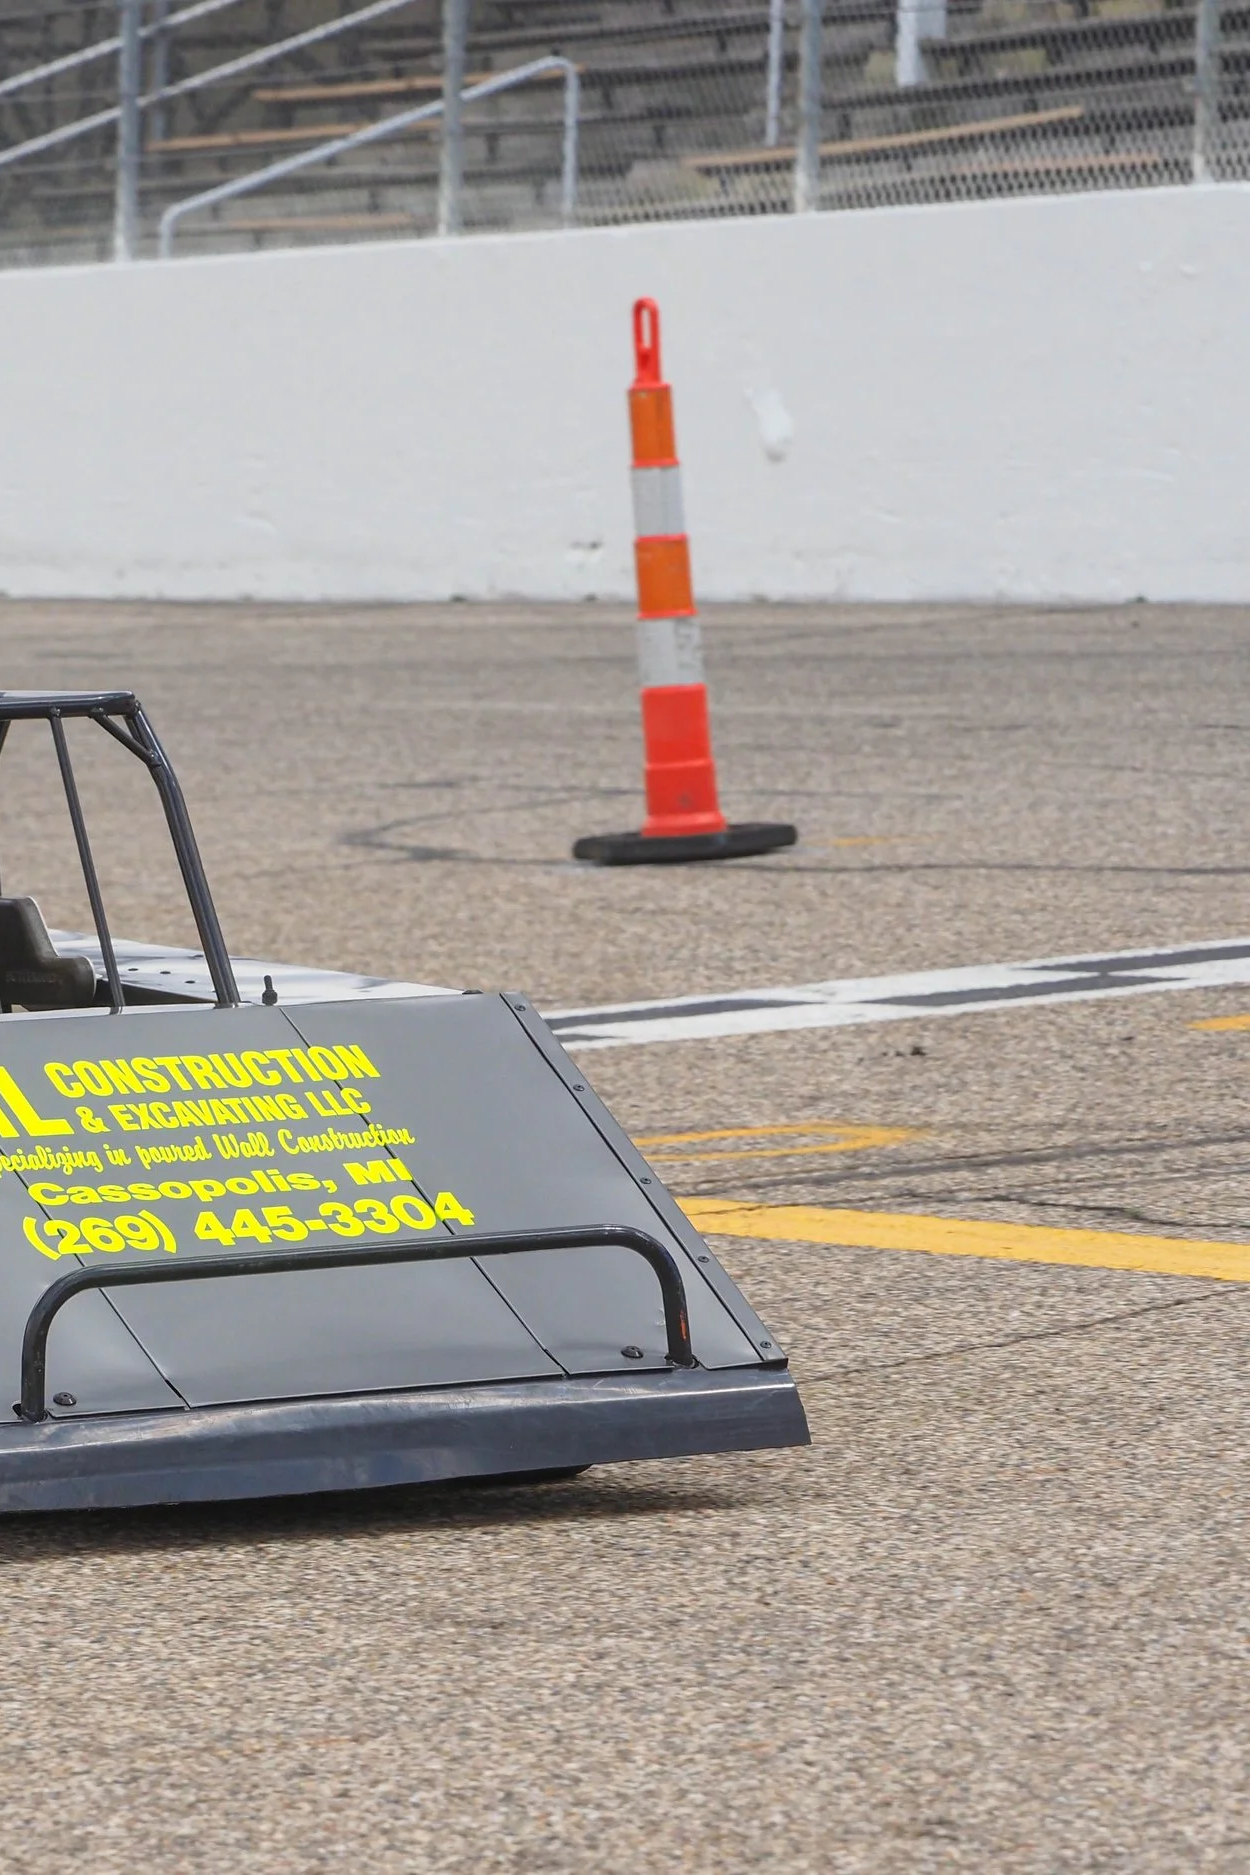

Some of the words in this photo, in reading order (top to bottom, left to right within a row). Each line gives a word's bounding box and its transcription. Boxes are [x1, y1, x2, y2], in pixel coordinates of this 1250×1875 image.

[43, 1044, 381, 1099] CONSTRUCTION
[75, 1106, 111, 1134] &
[107, 1093, 310, 1132] EXCAVATING
[304, 1087, 372, 1117] LLC
[103, 1143, 132, 1166] in
[134, 1135, 213, 1170] poured
[212, 1131, 275, 1160] Wall
[277, 1123, 416, 1155] Construction
[28, 1168, 338, 1206] Cassopolis,
[342, 1157, 415, 1186] MI
[22, 1208, 177, 1261] (269)
[193, 1191, 476, 1246] 445-3304
